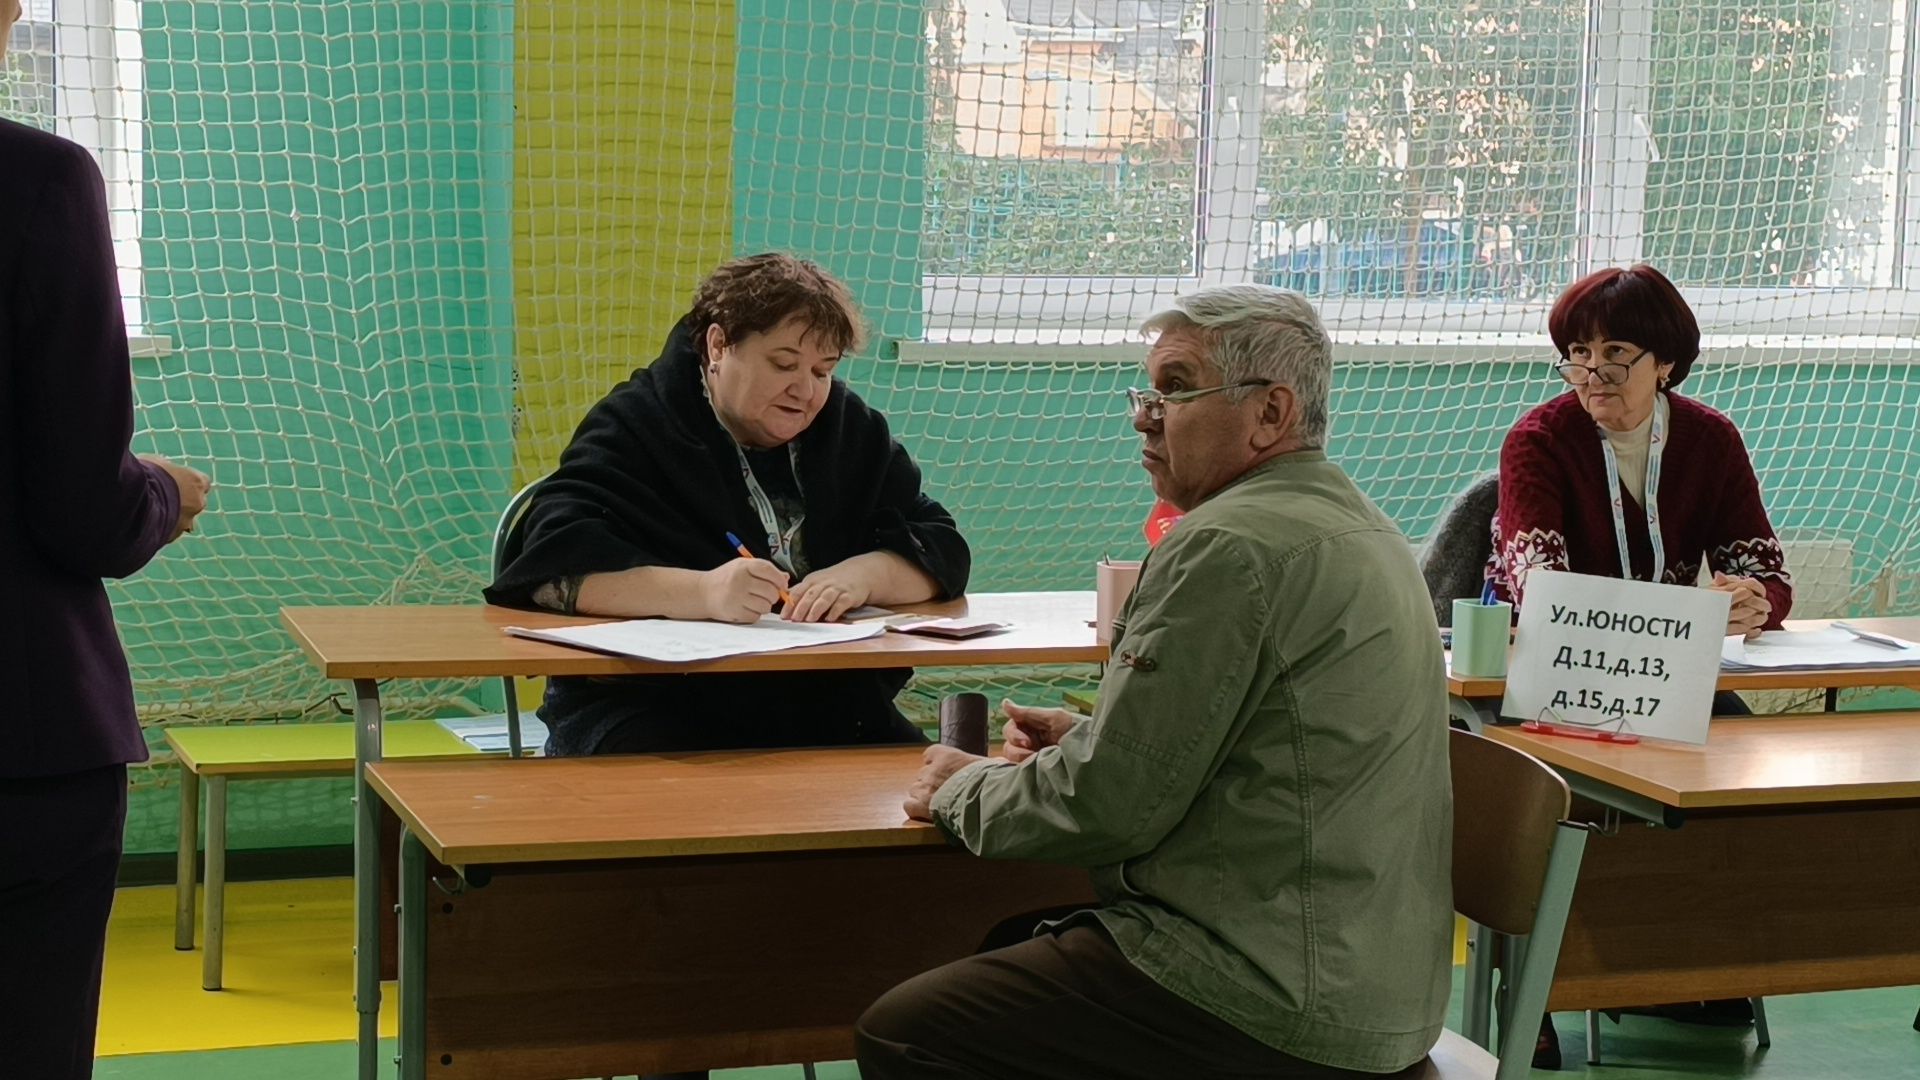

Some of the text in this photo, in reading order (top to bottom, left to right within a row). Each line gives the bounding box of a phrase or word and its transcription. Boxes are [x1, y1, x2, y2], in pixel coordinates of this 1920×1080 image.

[1550, 604, 1691, 640] Ул.ЮНОСТИ
[1553, 645, 1671, 682] Д.11,д.13,
[1551, 689, 1661, 717] д.15,д.17
